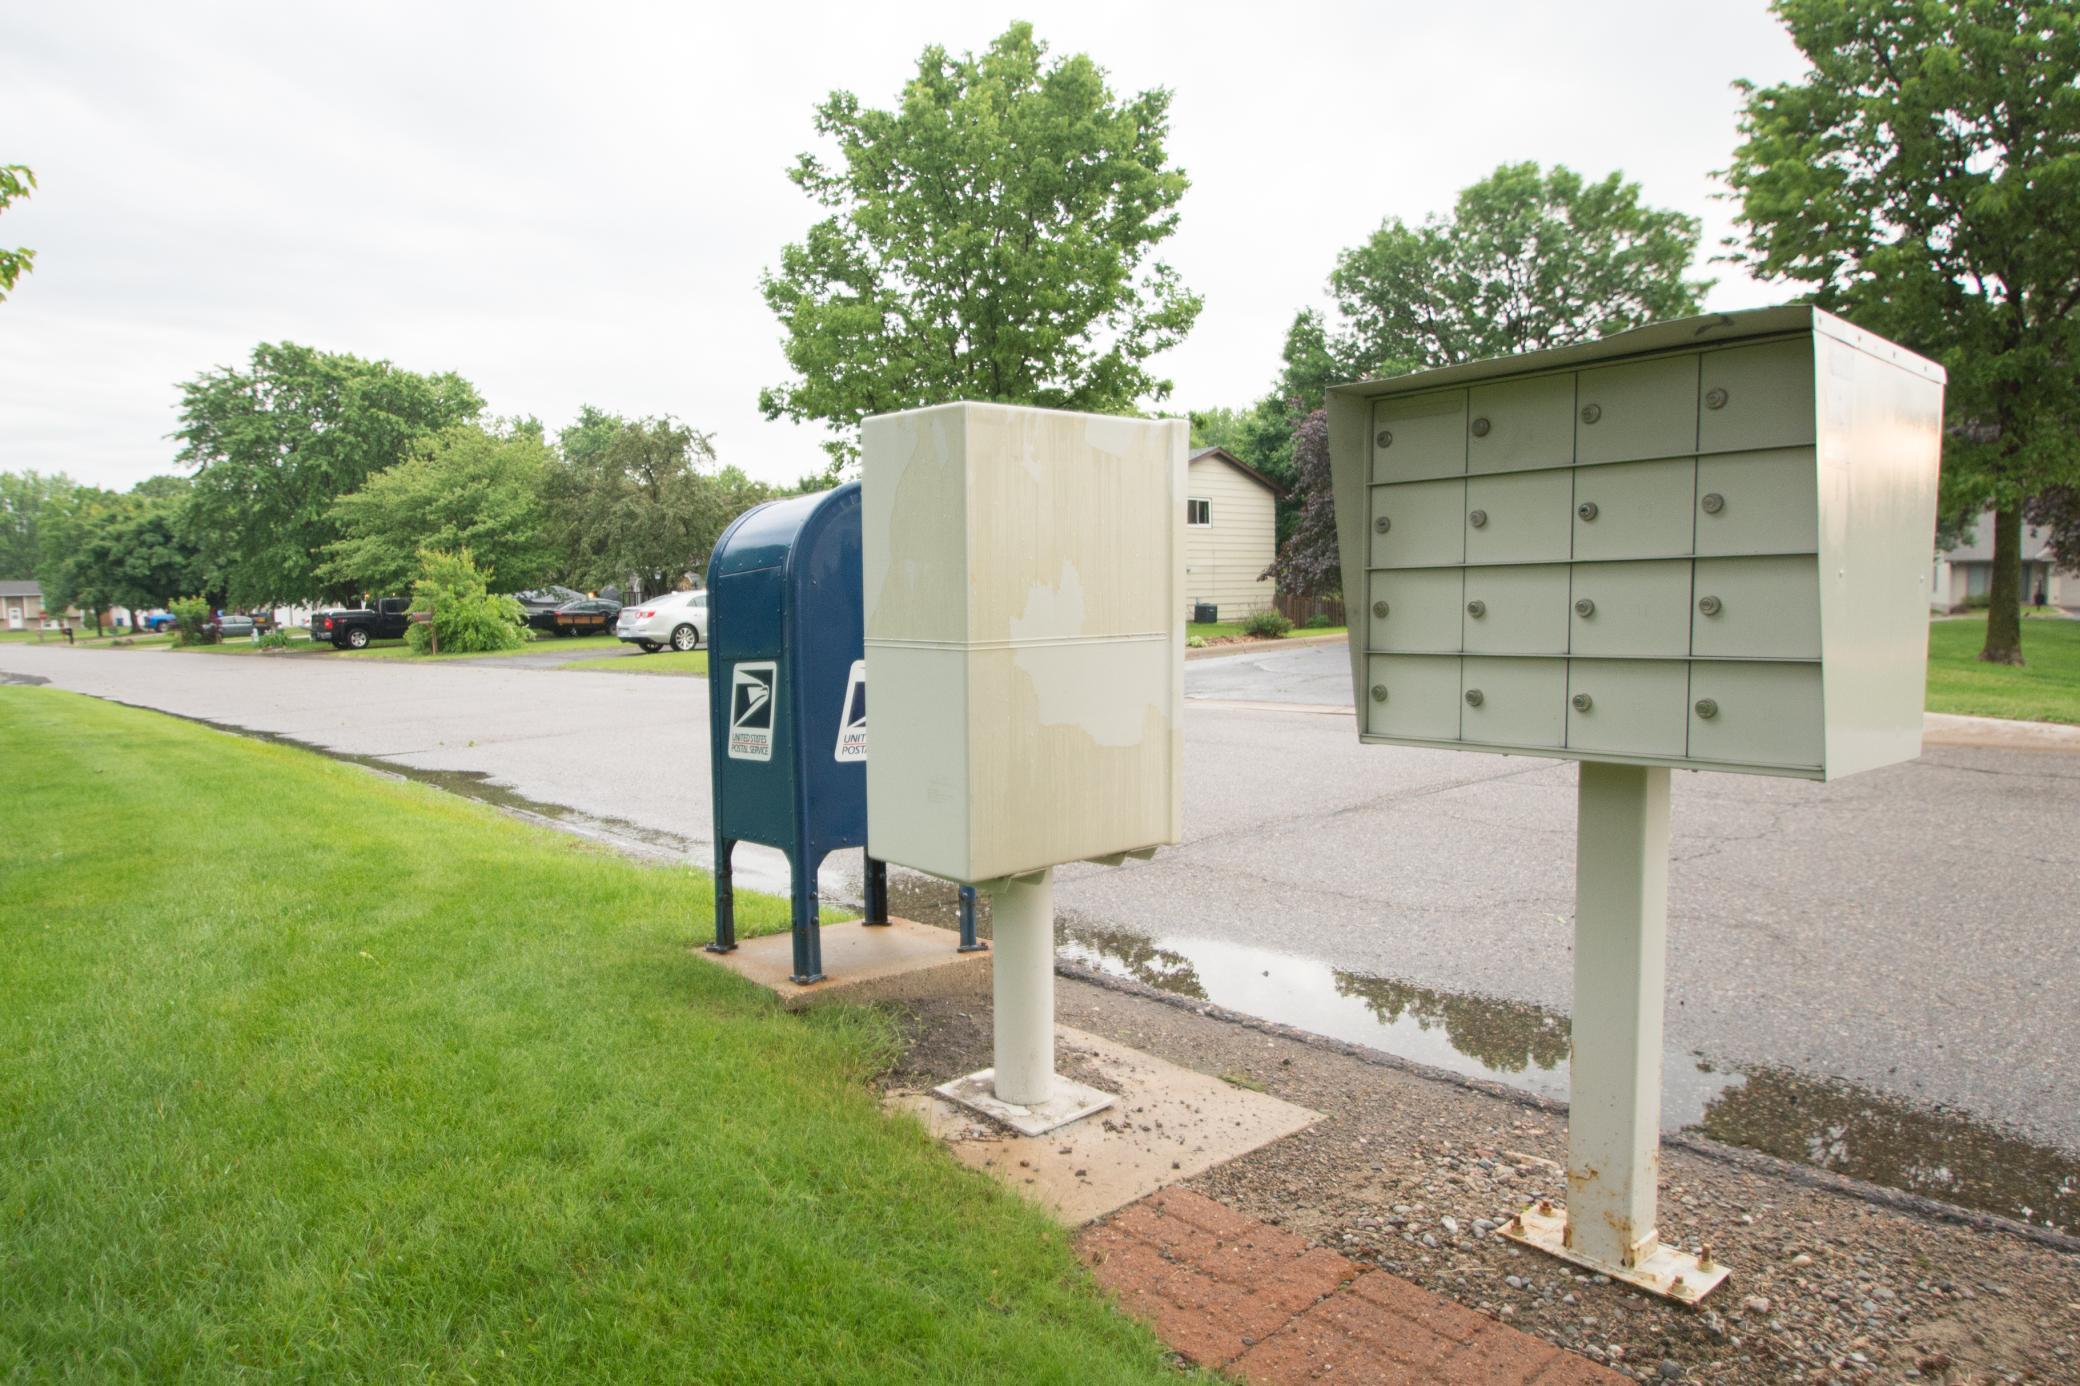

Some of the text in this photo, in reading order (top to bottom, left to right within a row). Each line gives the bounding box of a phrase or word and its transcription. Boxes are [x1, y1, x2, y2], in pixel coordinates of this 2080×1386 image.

[732, 733, 767, 744] UNITED STATES
[843, 733, 866, 744] UNIT
[749, 746, 769, 756] SERVICE
[842, 745, 867, 756] POST
